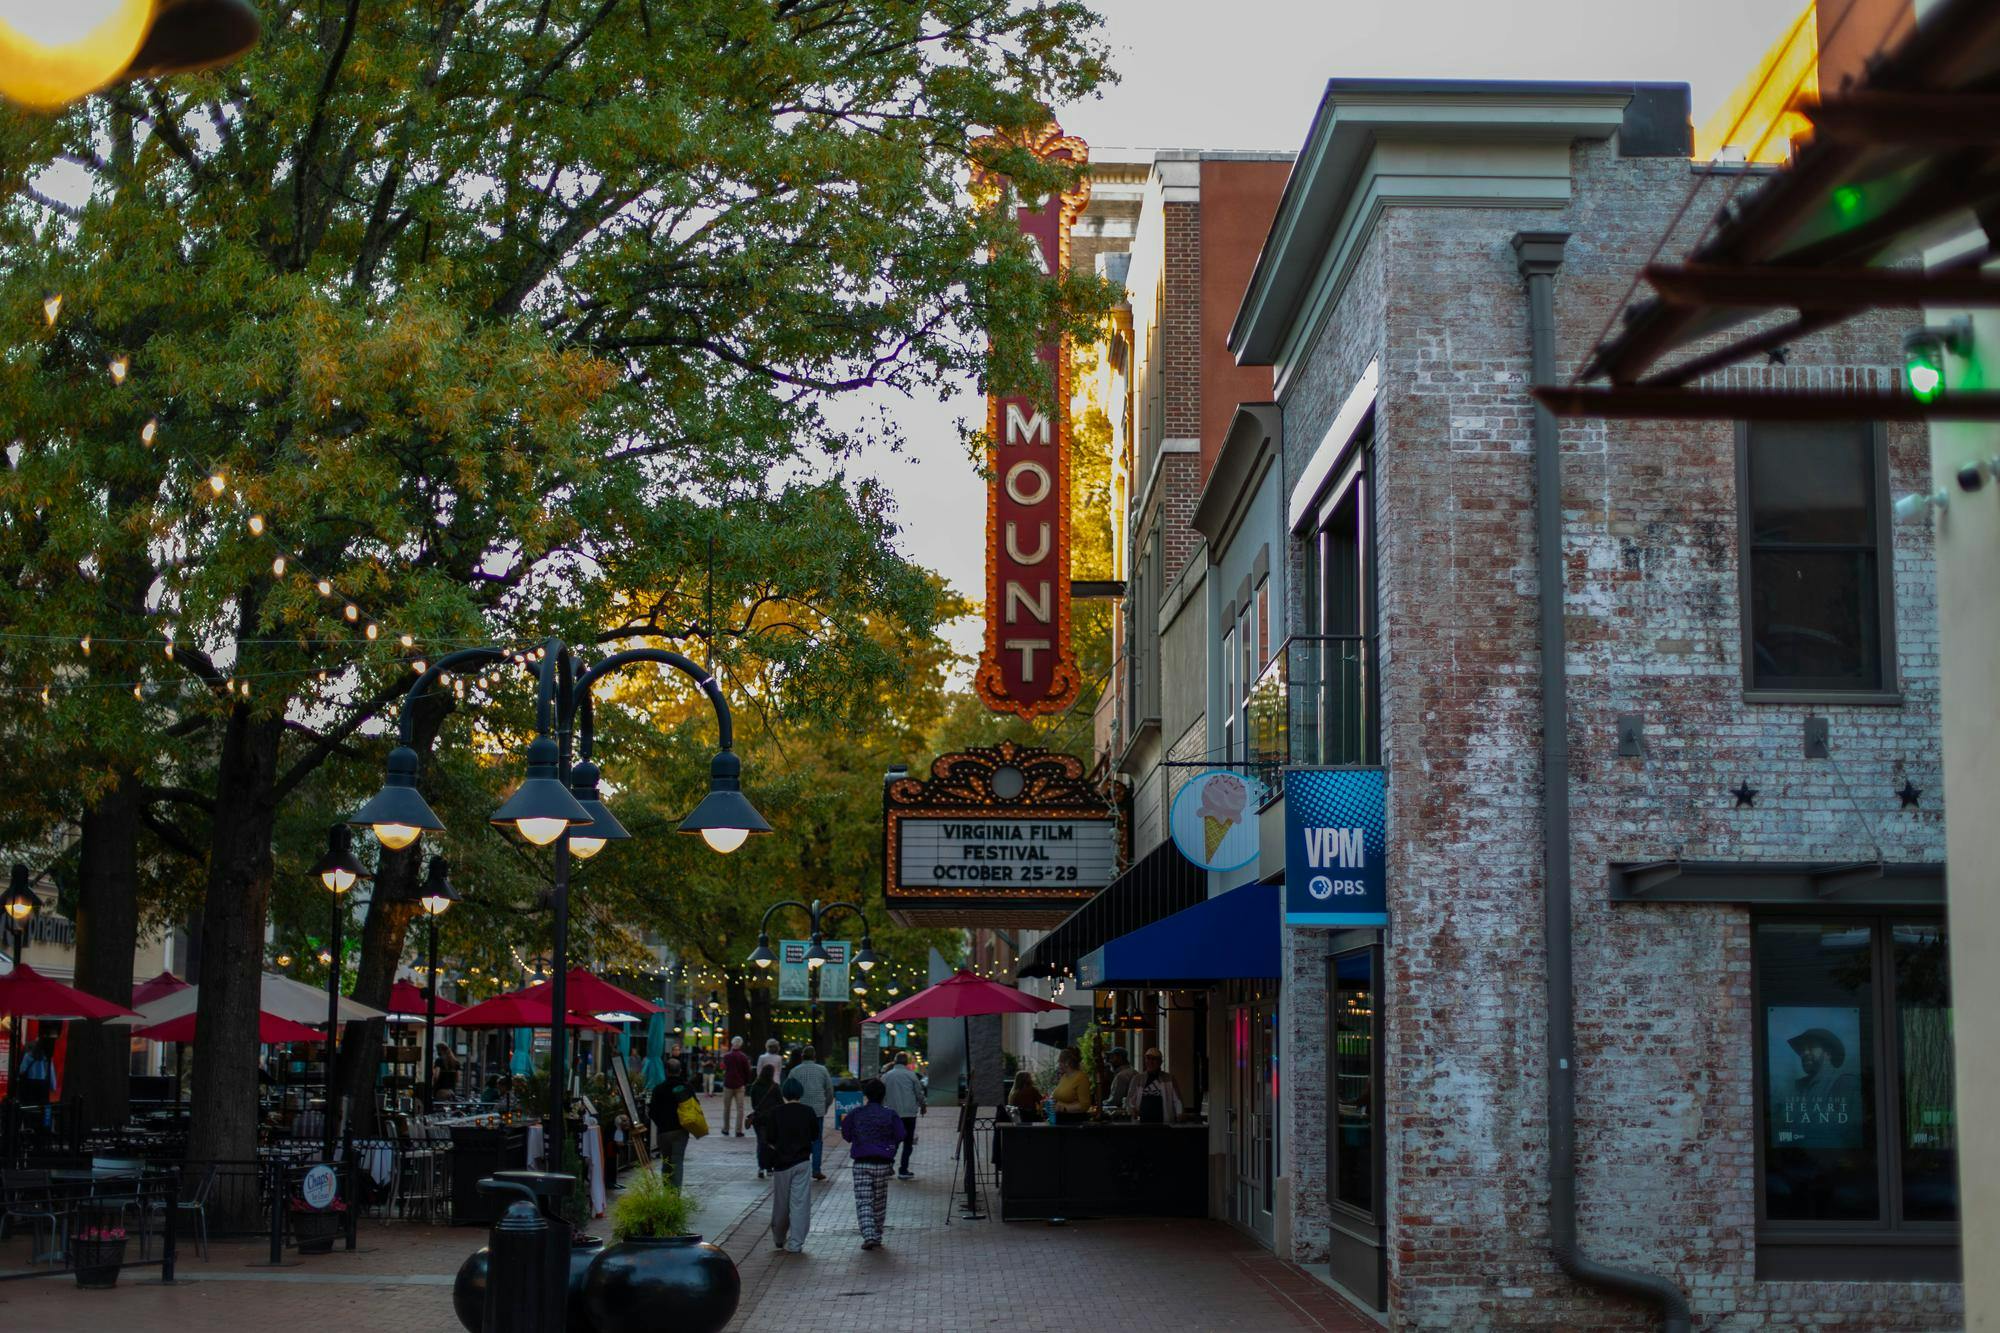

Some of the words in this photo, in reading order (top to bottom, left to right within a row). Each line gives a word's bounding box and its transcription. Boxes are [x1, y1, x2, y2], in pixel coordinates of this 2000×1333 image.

[943, 824, 1023, 840] VIRGINIA
[1030, 825, 1073, 840] FILM
[963, 845, 1050, 860] FESTIVAL
[1304, 827, 1364, 868] VPM
[933, 864, 1013, 881] OCTOBER
[1020, 865, 1078, 881] 25-29
[1334, 879, 1365, 895] PBS
[1785, 1103, 1848, 1112] HEART
[1785, 1112, 1848, 1124] LAND
[307, 1172, 329, 1191] Chaps
